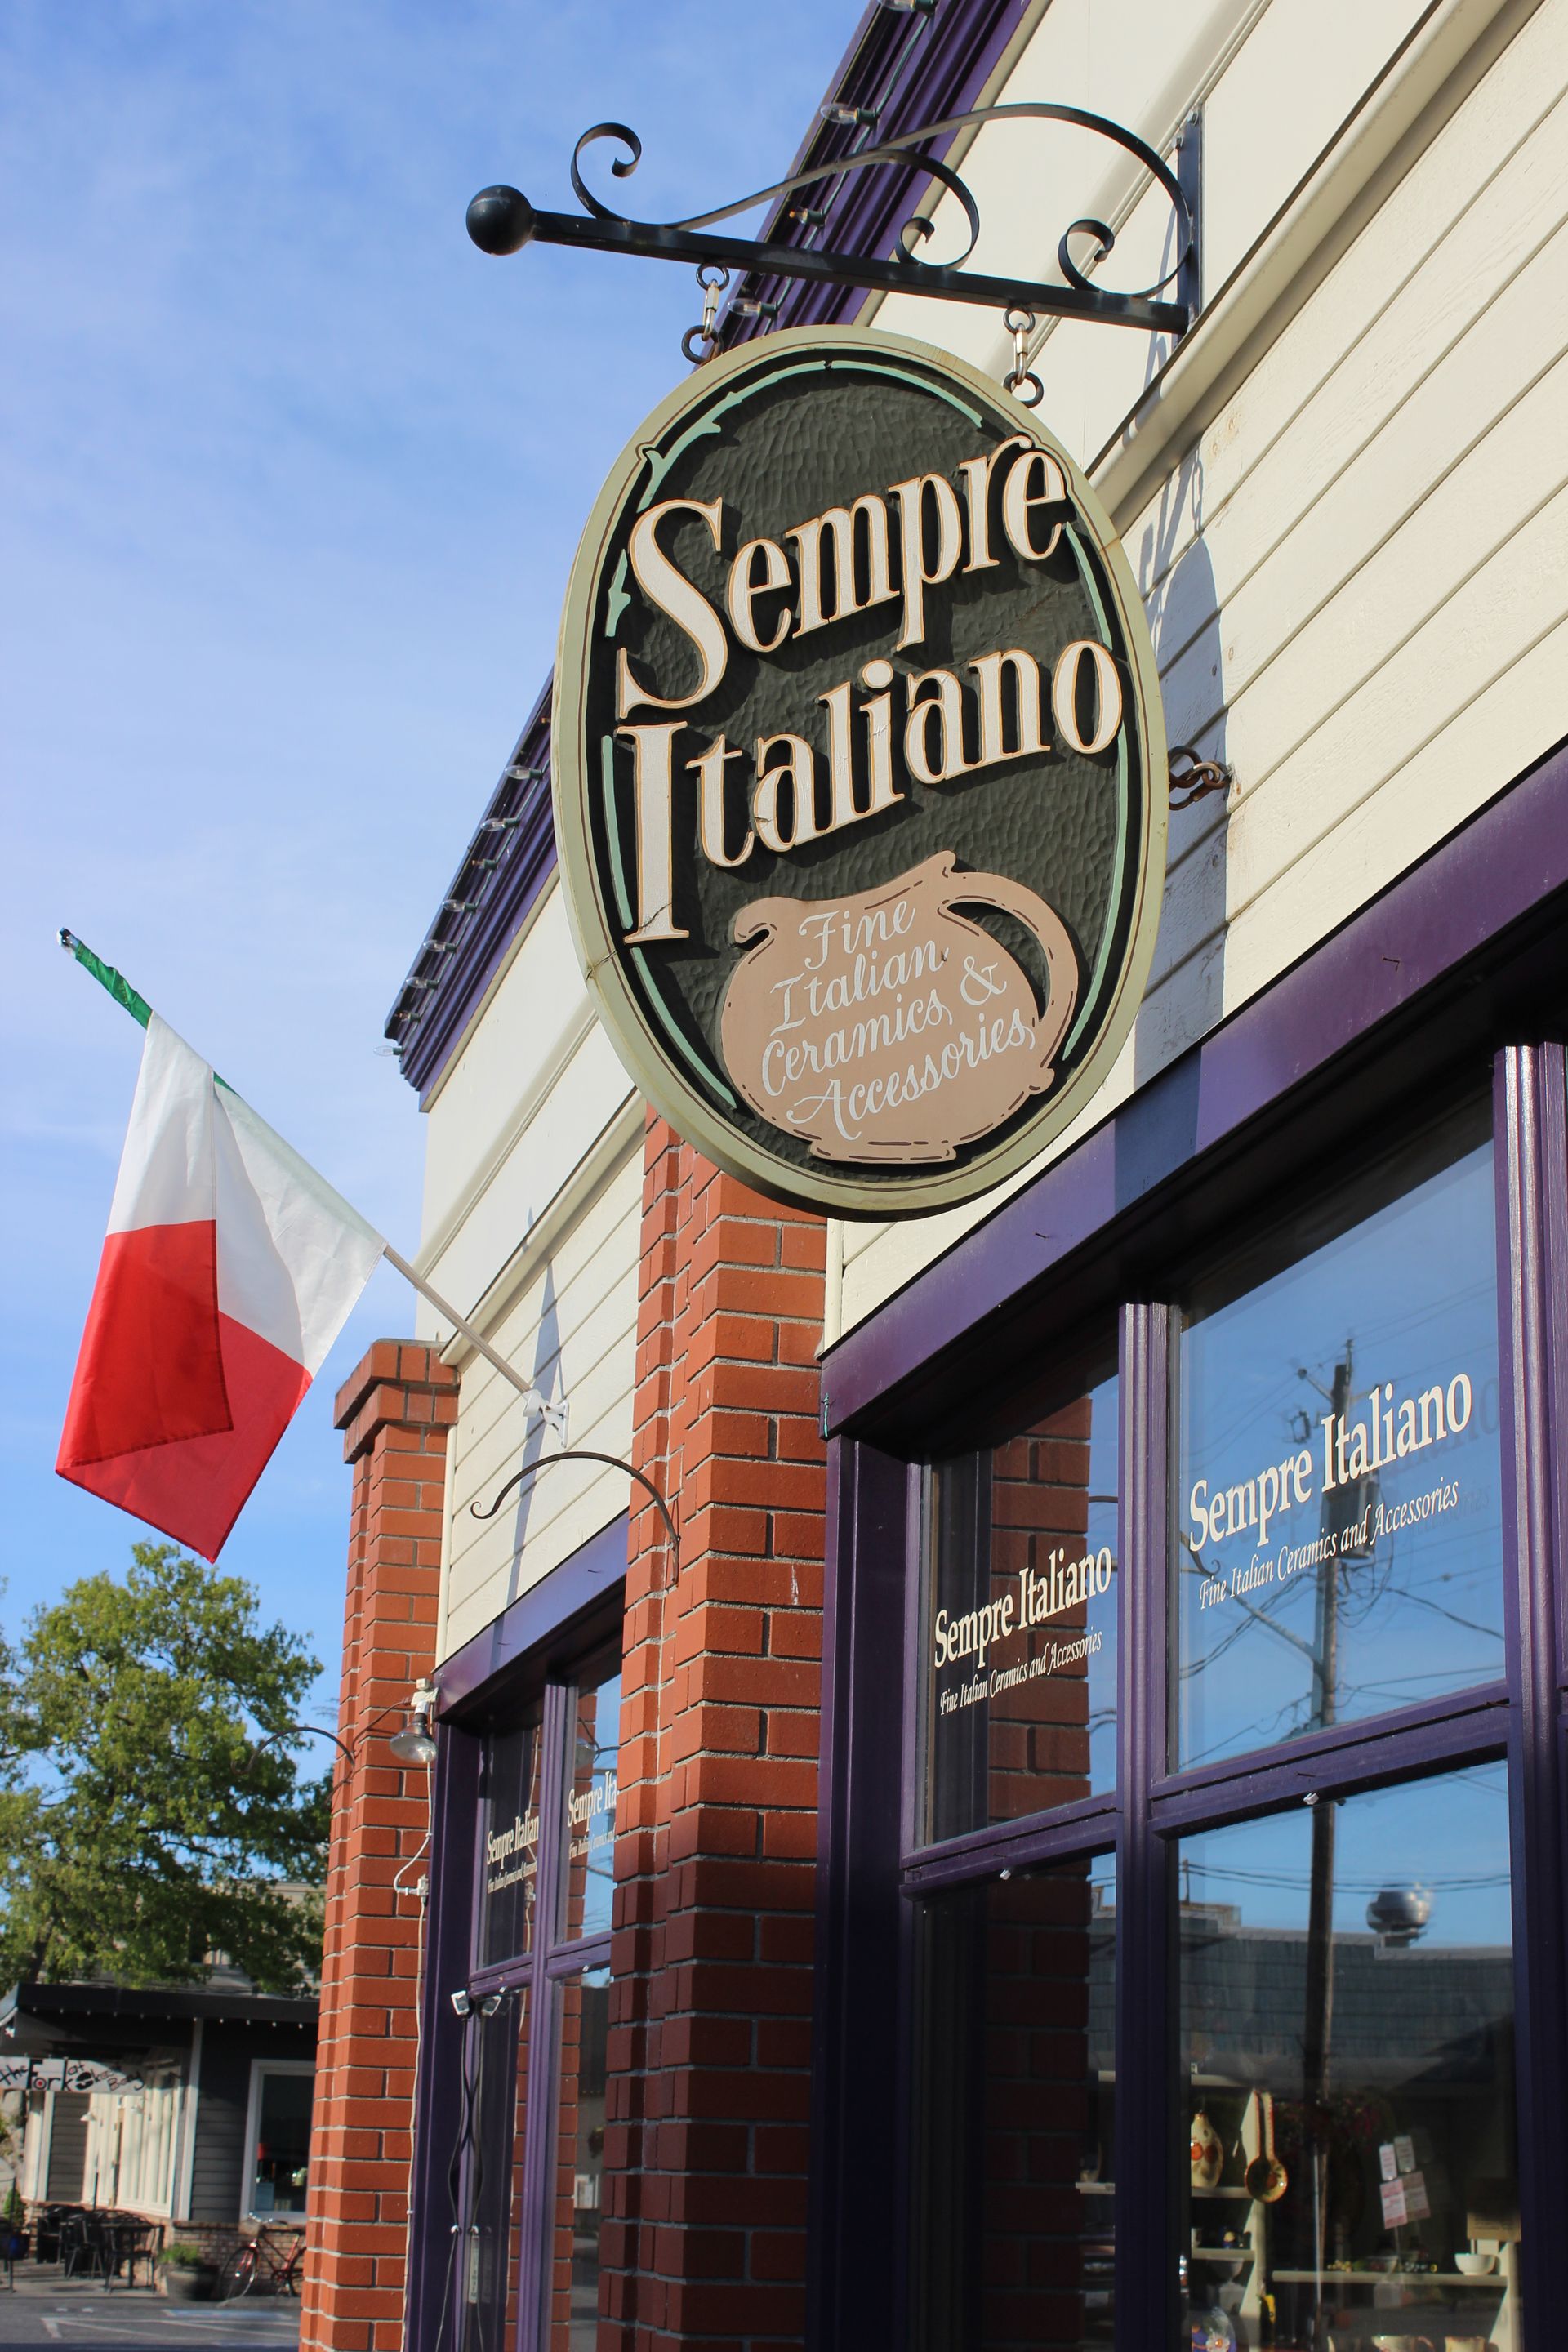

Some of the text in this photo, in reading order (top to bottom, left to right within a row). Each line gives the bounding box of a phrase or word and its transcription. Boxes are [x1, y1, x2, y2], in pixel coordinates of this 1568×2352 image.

[617, 434, 1067, 719] Sempre
[615, 641, 1123, 943] Italiano
[769, 939, 950, 1037] Italian
[799, 900, 916, 969] Fine
[761, 955, 1008, 1097] Ceramics &
[786, 1008, 1036, 1141] Accessories
[1189, 1373, 1472, 1552] Sempre Italiano
[1200, 1477, 1459, 1610] Fine Italian Ceramics and Accessories
[934, 1546, 1112, 1669] Sempre Italiano
[940, 1625, 1102, 1716] Fine Italian Ceramics and Accessories
[487, 1829, 514, 1870] Sempre
[514, 1810, 539, 1851] Italian
[568, 1786, 603, 1833] Sempre
[26, 2058, 72, 2091] Fork
